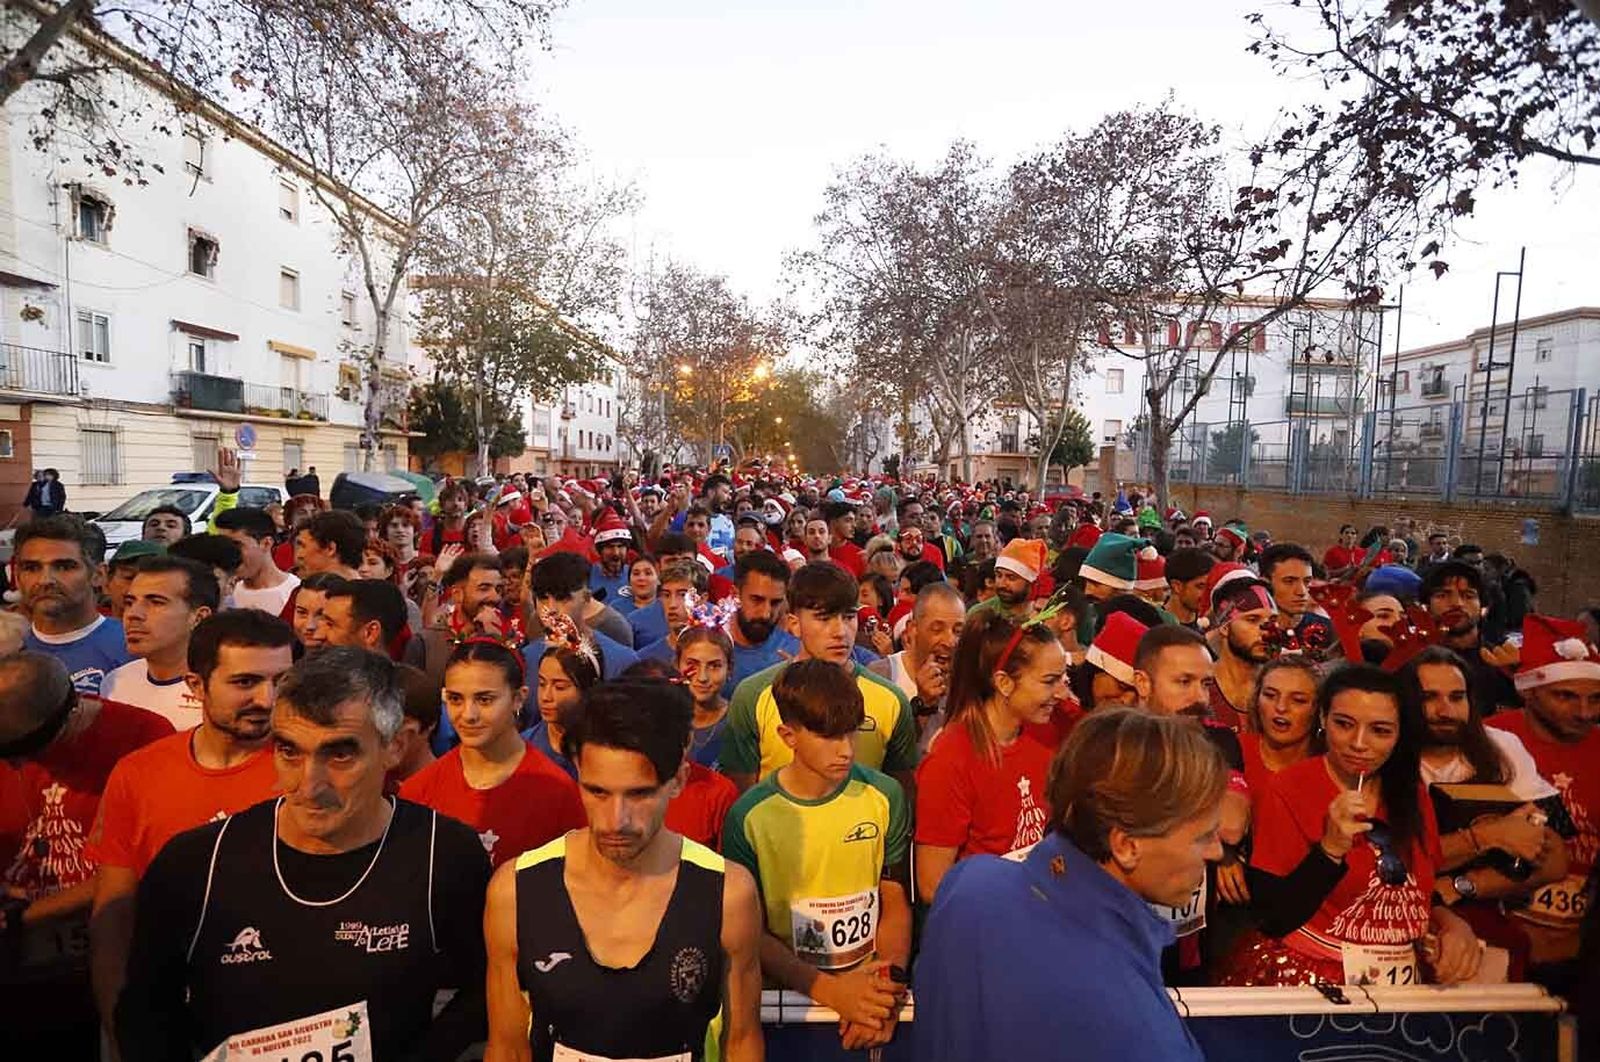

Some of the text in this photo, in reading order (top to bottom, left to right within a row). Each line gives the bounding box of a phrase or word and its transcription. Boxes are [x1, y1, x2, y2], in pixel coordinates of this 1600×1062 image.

[1537, 888, 1585, 914] 436
[832, 911, 870, 947] 628
[277, 1030, 293, 1039] SAN
